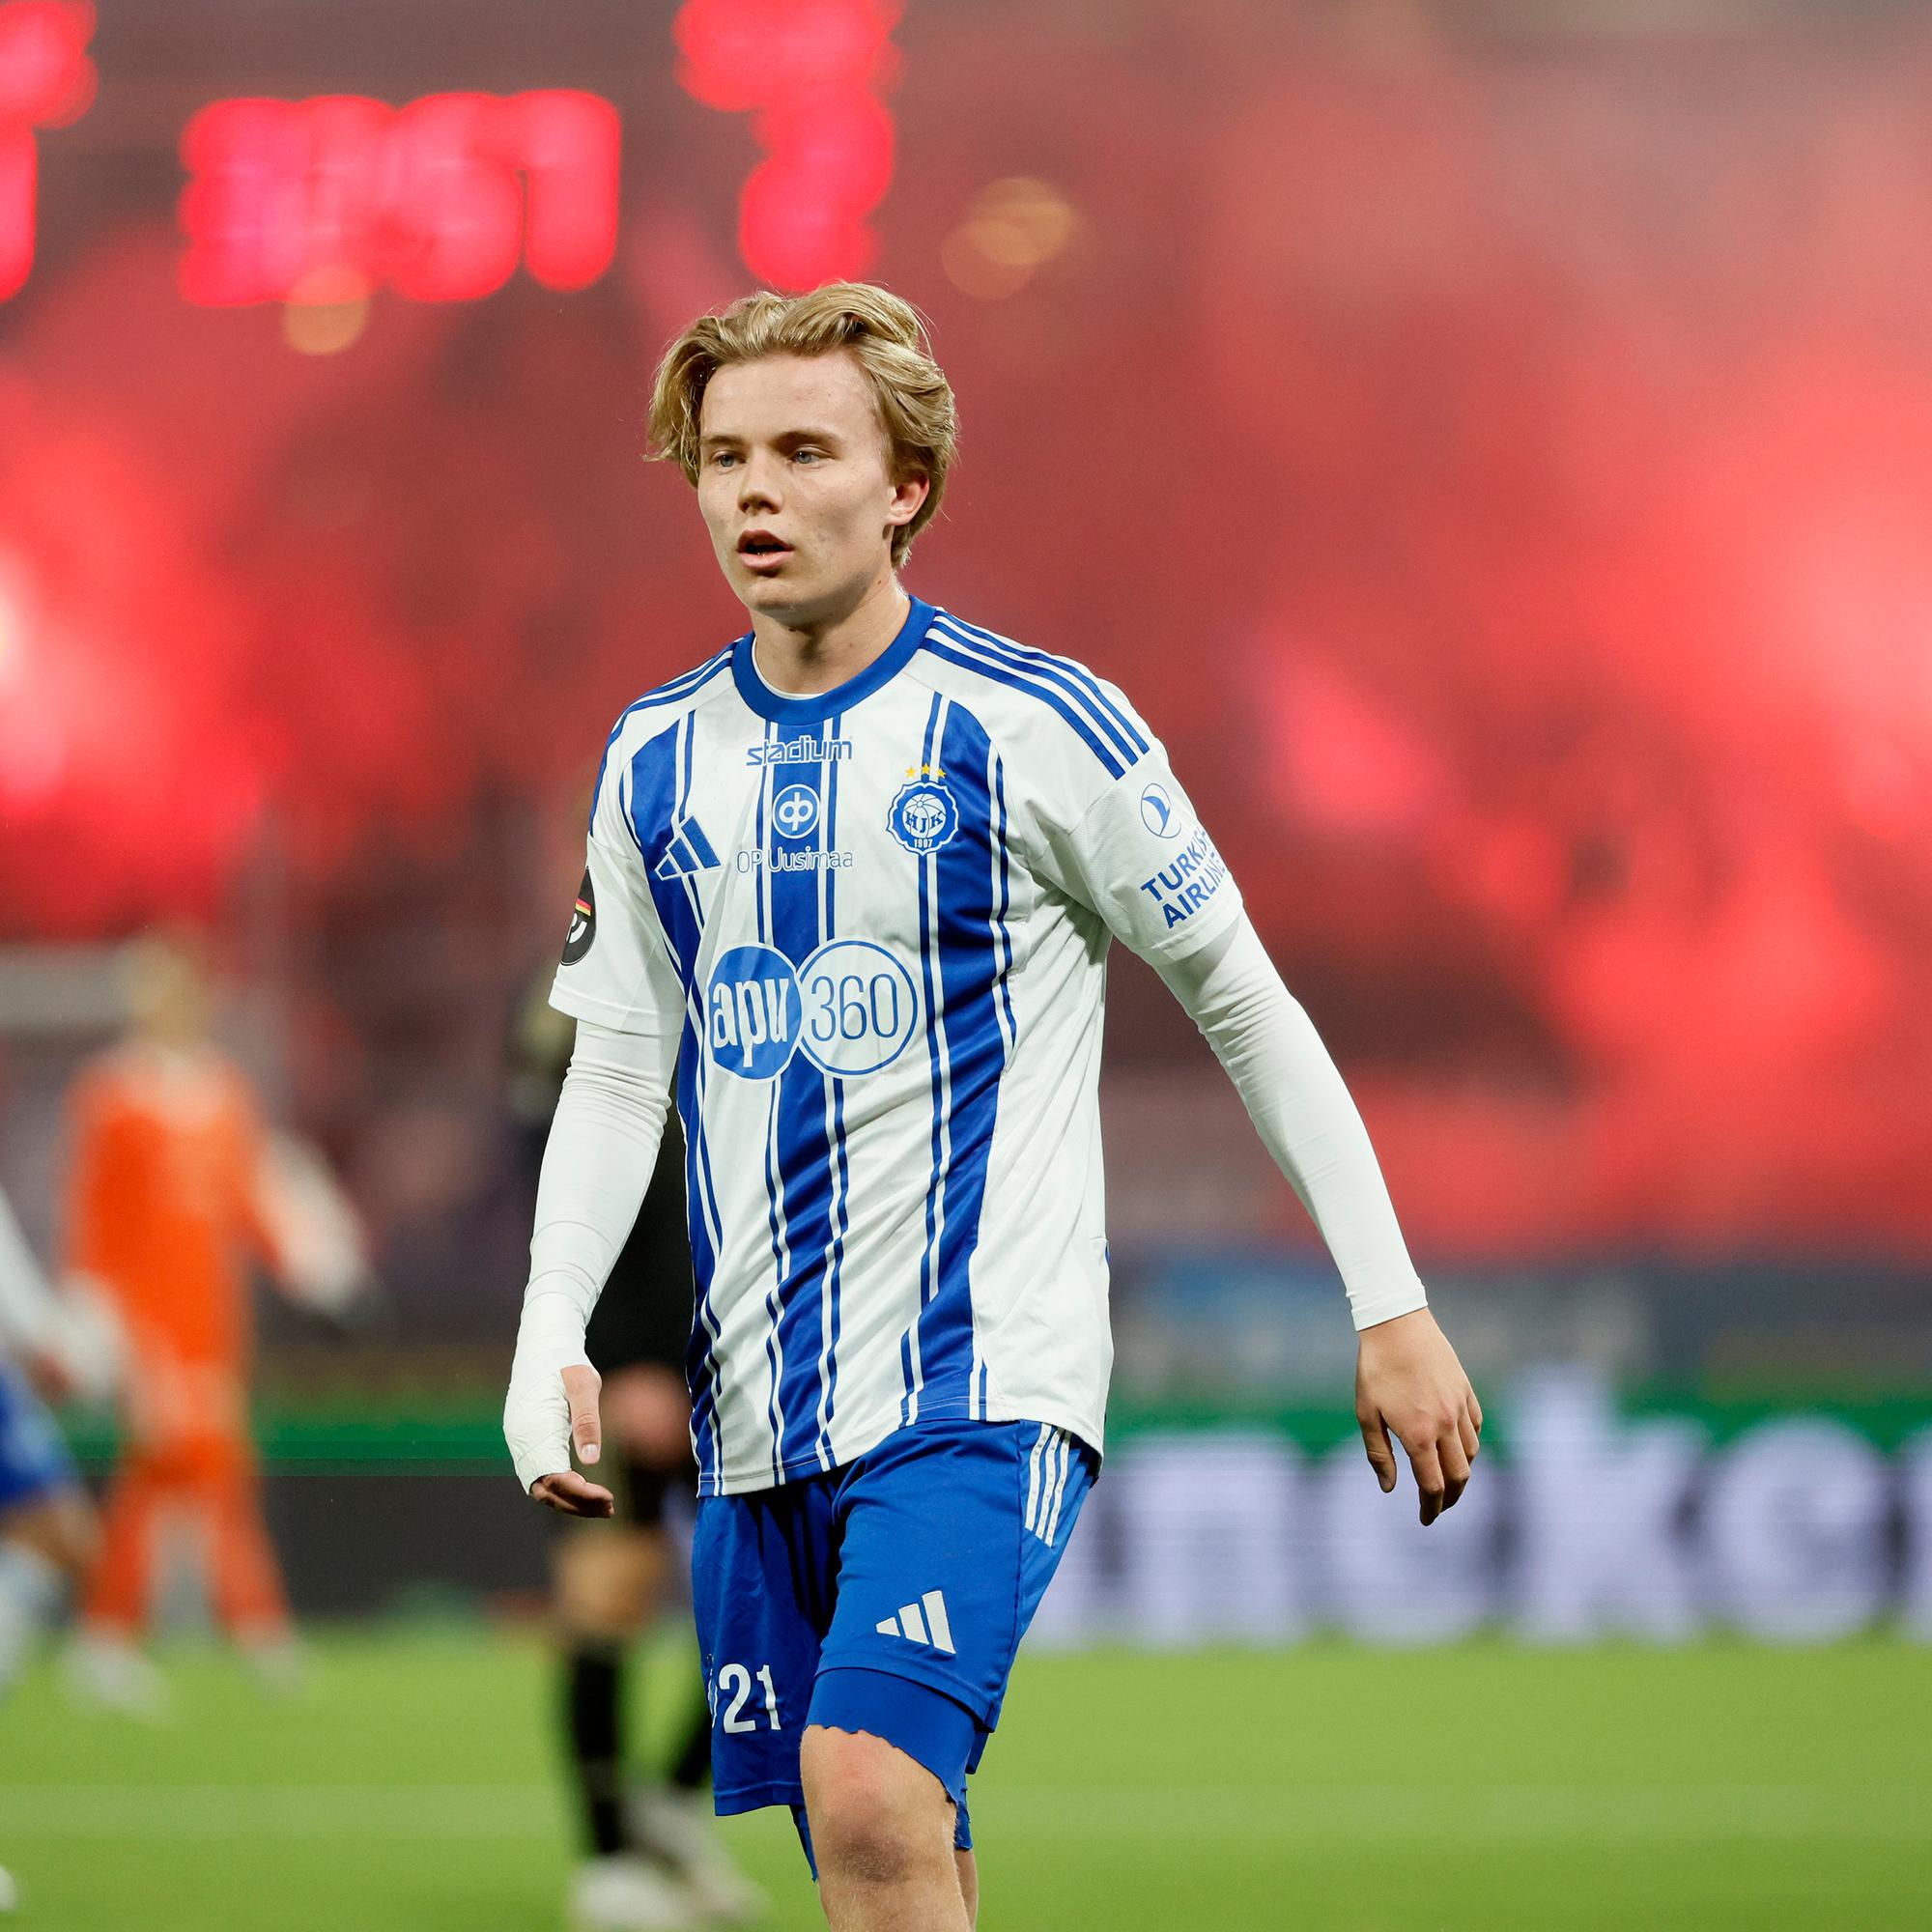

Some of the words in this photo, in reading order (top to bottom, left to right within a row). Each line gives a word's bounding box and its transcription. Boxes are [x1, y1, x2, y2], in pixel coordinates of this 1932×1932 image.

[746, 735, 852, 766] stadium
[905, 810, 944, 834] HJK
[913, 838, 933, 848] 1907
[736, 850, 763, 873] OP
[768, 846, 854, 871] Uusimaa
[1162, 851, 1226, 929] AIRLINE
[713, 978, 790, 1067] apu
[810, 973, 899, 1042] 360
[719, 1662, 781, 1734] 21
